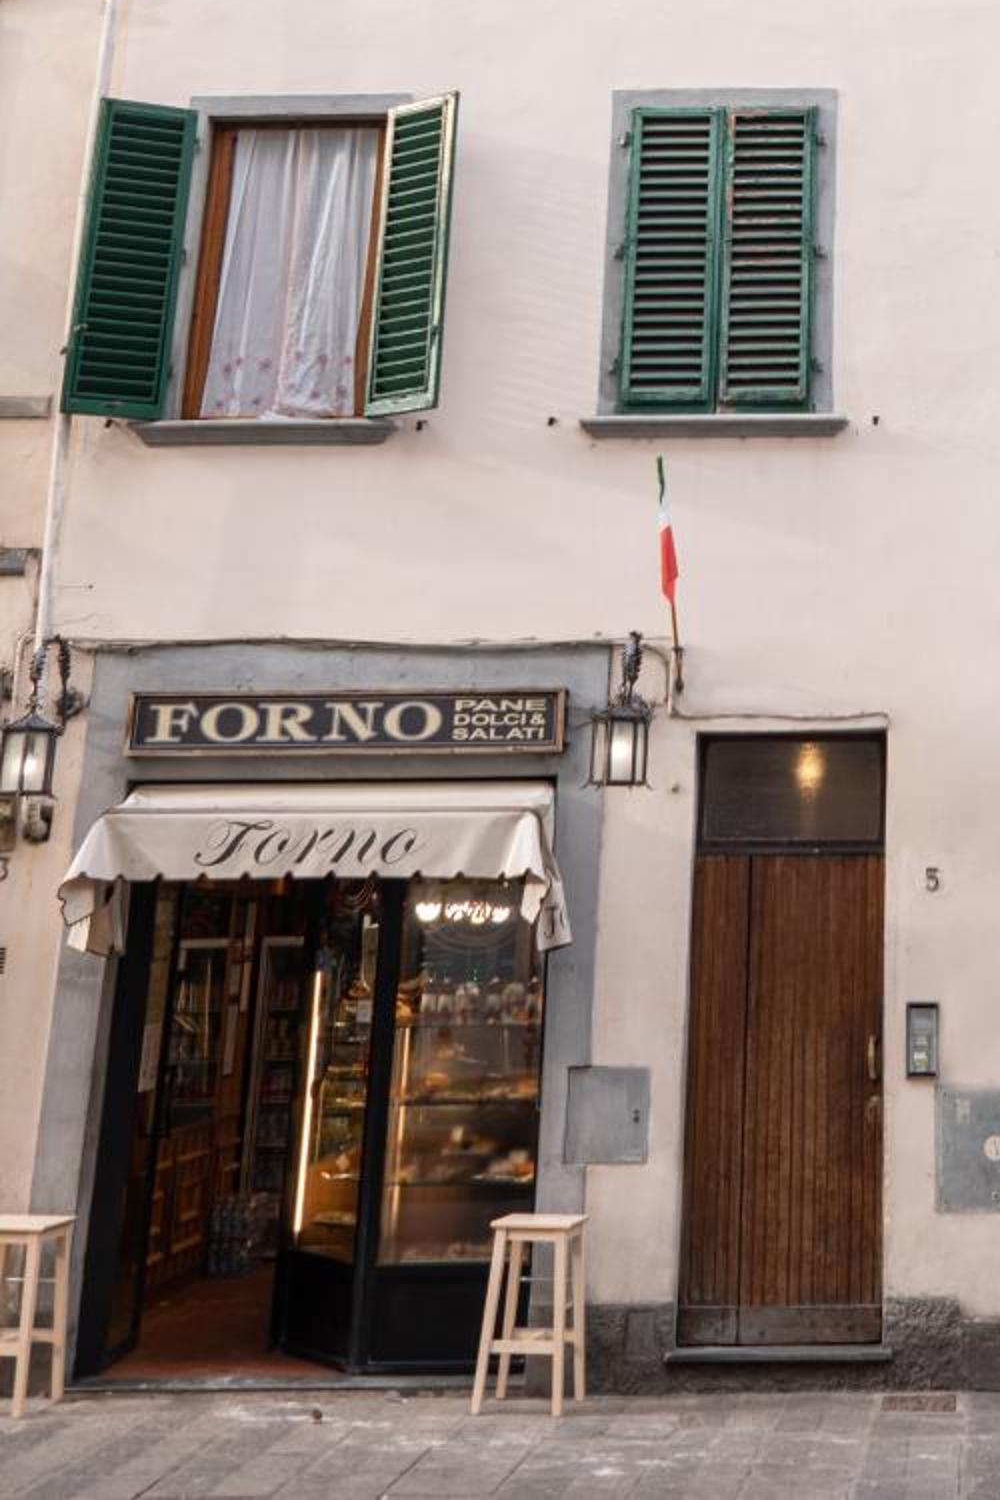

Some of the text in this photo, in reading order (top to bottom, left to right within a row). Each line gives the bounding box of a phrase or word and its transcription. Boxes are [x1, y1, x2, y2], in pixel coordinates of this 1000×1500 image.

[454, 699, 545, 711] PANE
[146, 700, 443, 743] FORNO
[453, 713, 526, 726] DOLCI
[452, 727, 545, 740] SALATI
[194, 820, 420, 867] Forno
[926, 867, 940, 892] 5
